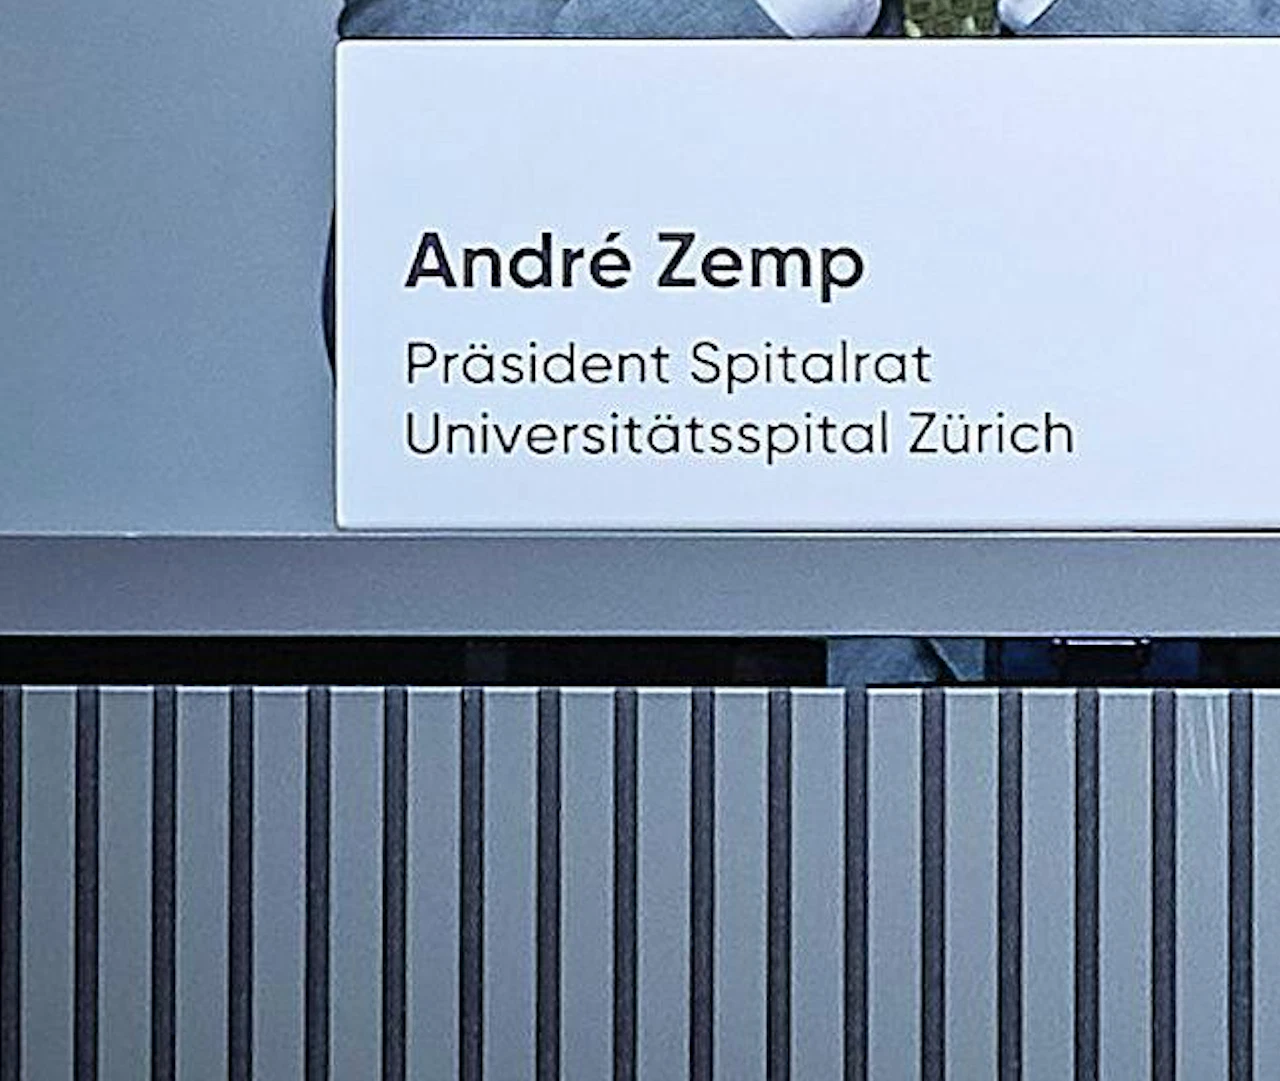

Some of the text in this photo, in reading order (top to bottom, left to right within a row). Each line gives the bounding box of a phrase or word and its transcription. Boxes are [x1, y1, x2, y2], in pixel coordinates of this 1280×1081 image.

[404, 231, 864, 304] André Zemp
[406, 338, 932, 395] Präsident Spitalrat
[406, 410, 1073, 466] Universitätsspital Zürich
